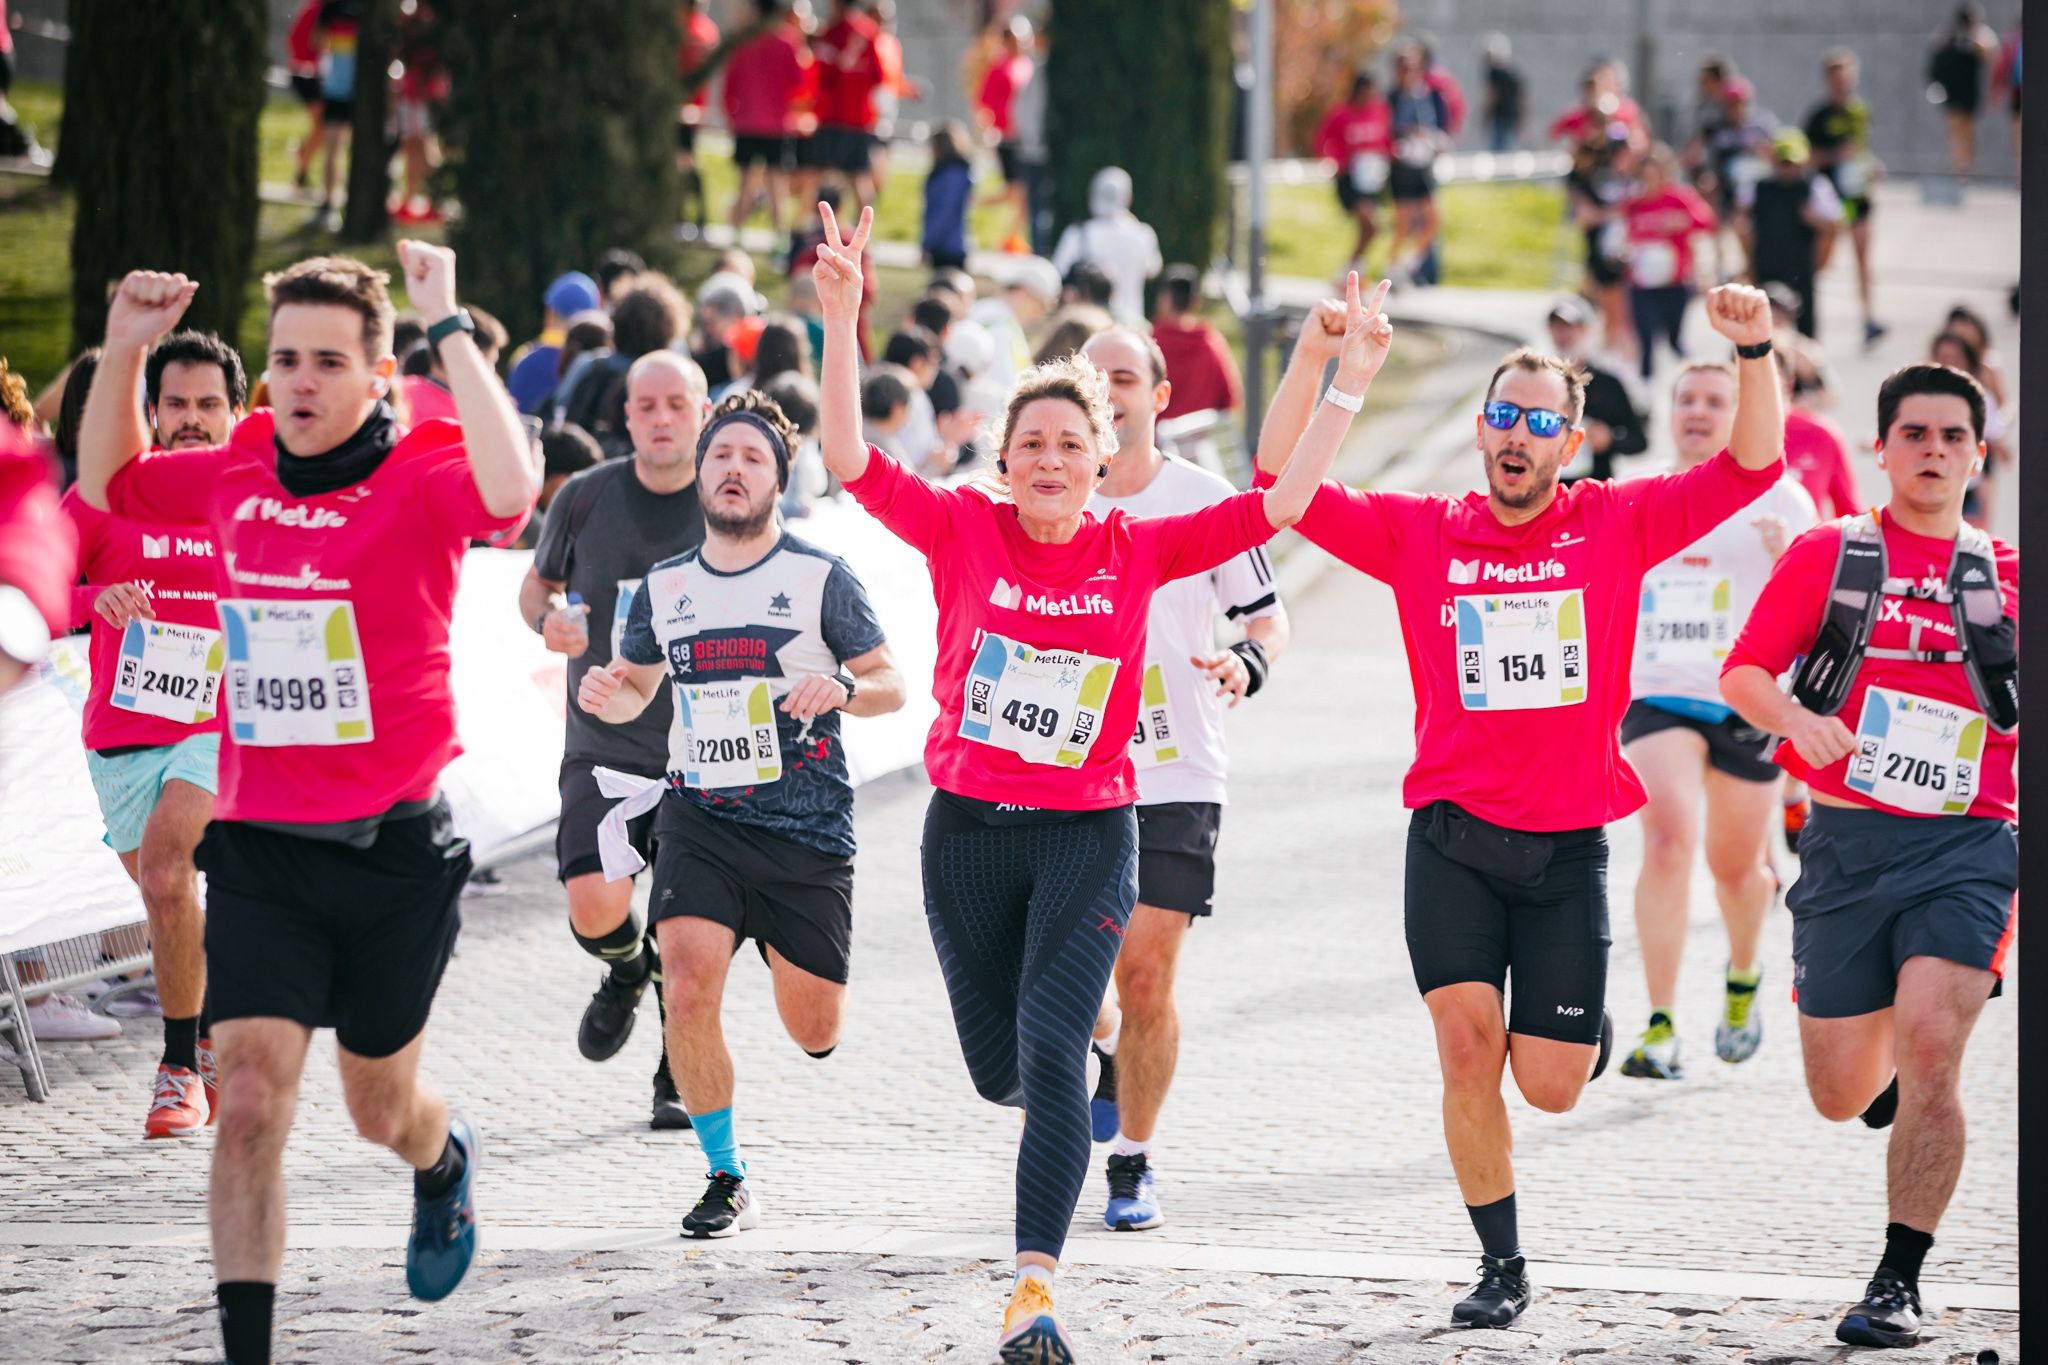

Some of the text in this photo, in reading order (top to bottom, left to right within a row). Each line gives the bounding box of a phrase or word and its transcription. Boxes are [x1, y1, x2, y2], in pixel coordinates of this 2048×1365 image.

[1482, 558, 1568, 583] MetLife
[183, 590, 218, 601] MADRID
[1026, 594, 1114, 616] MetLife
[1504, 598, 1550, 610] MetLife
[266, 606, 314, 622] MetLife
[166, 628, 207, 643] MetLife
[693, 637, 767, 660] BEHOBIA
[695, 660, 714, 672] SAN
[1034, 654, 1081, 667] MetLife
[1498, 653, 1546, 682] 154
[142, 670, 199, 700] 2402
[255, 677, 328, 711] 4998
[702, 688, 740, 699] MetLife
[1001, 699, 1060, 738] 439
[1917, 703, 1960, 722] MetLife
[697, 737, 751, 763] 2208
[1884, 753, 1947, 791] 2705
